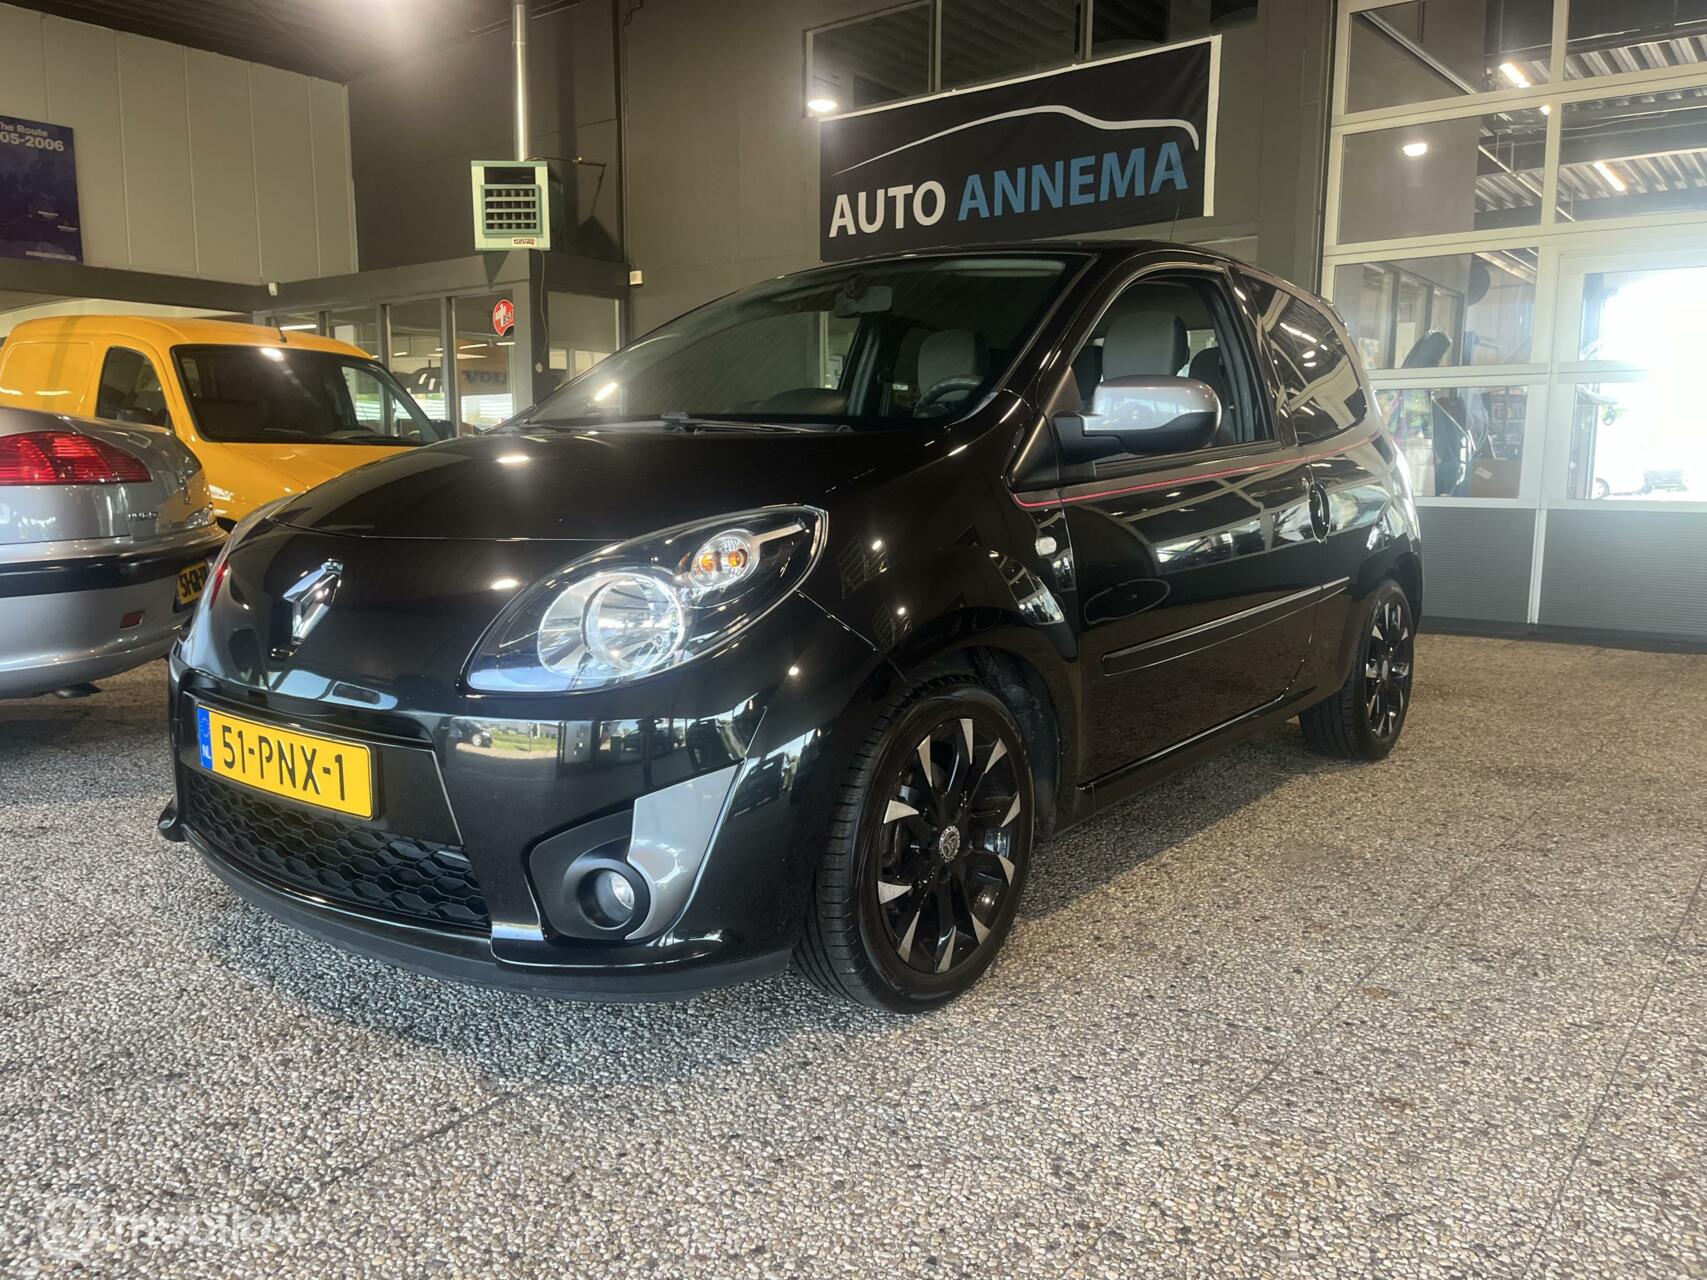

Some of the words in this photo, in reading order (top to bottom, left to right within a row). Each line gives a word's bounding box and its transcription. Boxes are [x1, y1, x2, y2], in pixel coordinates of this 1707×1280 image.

[16, 124, 49, 137] Route
[0, 131, 65, 152] 05-2006
[829, 180, 946, 238] AUTO
[957, 141, 1189, 221] ANNEMA
[202, 743, 212, 760] NL
[221, 724, 346, 802] 51-PNX-1
